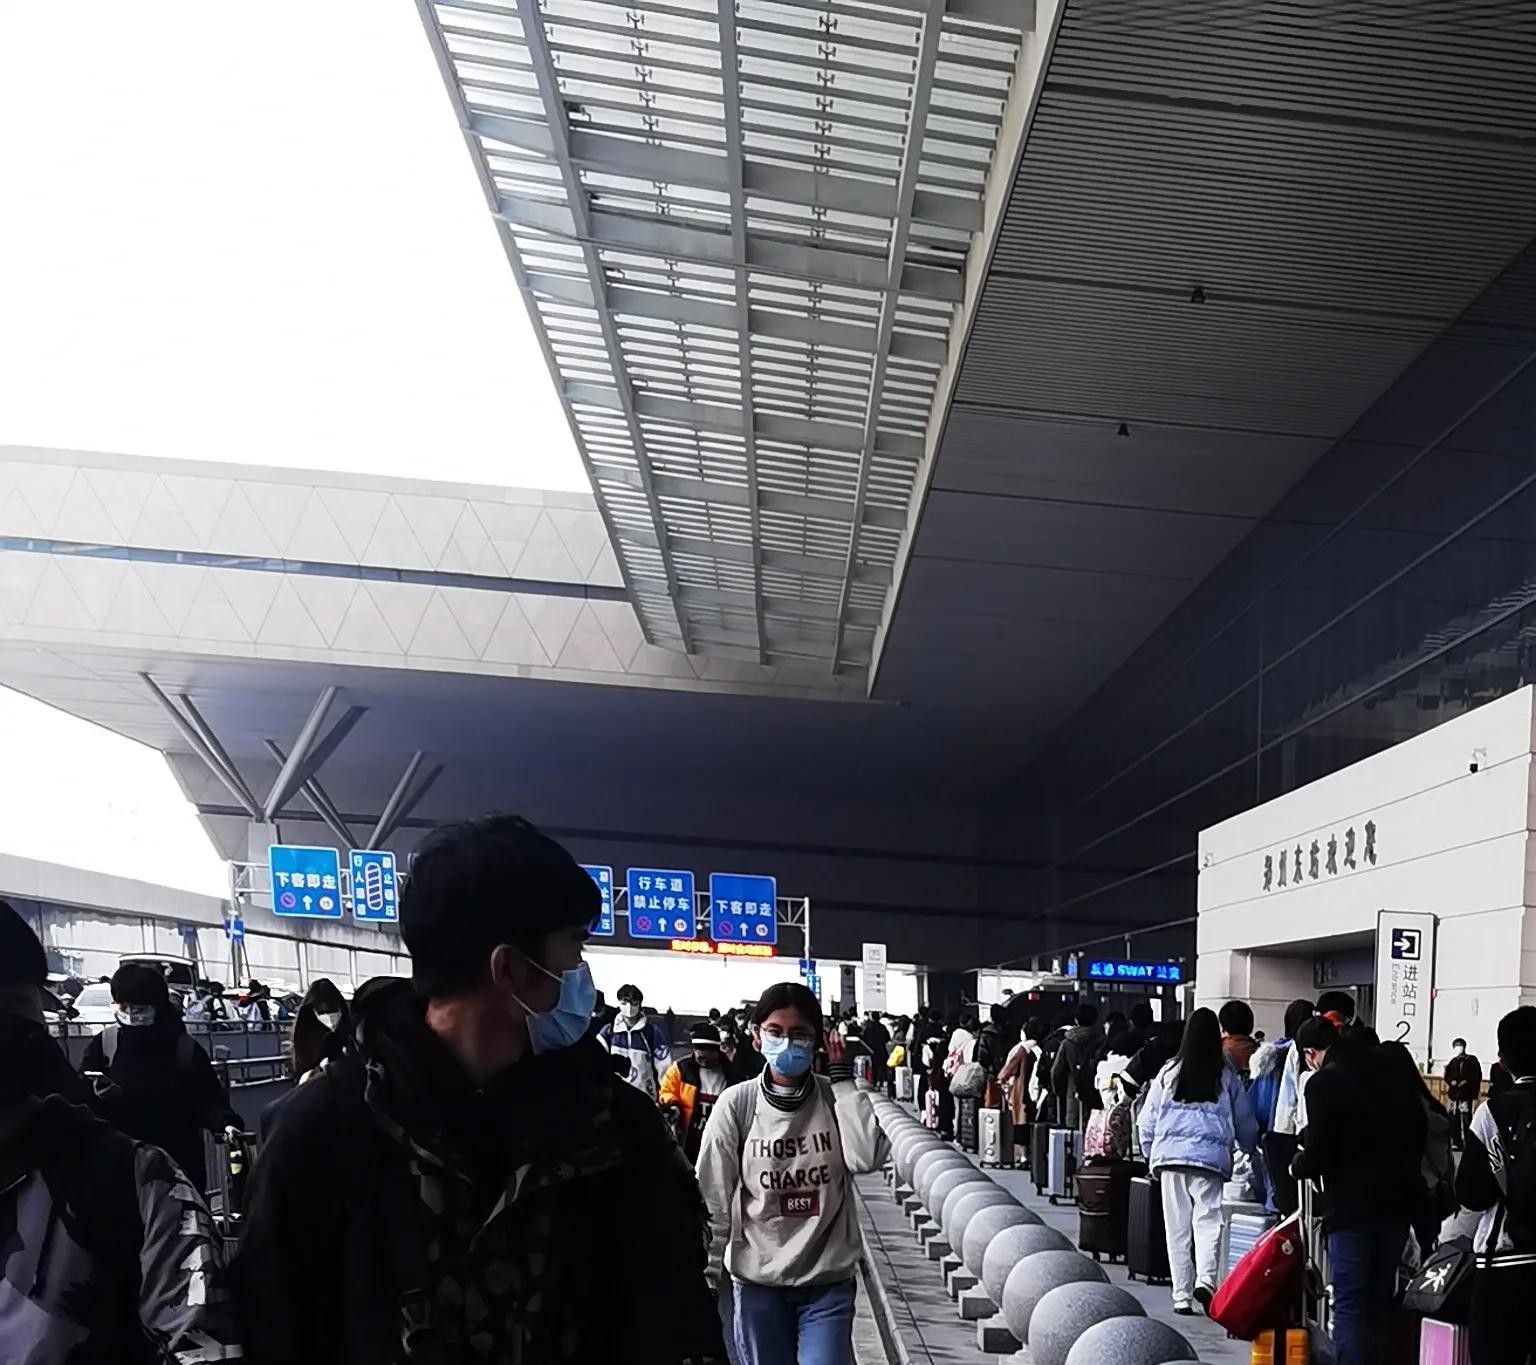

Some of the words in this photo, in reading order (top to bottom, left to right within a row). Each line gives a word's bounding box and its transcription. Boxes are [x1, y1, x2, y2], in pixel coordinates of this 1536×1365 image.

[275, 872, 337, 890] 下客即走
[638, 876, 684, 893] 行车道
[633, 894, 691, 912] 禁止停车
[715, 899, 772, 918] 下客即走
[1117, 965, 1155, 977] SWAT
[1390, 963, 1400, 1005] Entrance
[1402, 963, 1418, 1017] 进站口
[1396, 1020, 1411, 1046] 2
[750, 1136, 809, 1160] THOSE
[813, 1131, 832, 1153] IN
[760, 1165, 832, 1190] CHARGE
[787, 1197, 812, 1211] BEST
